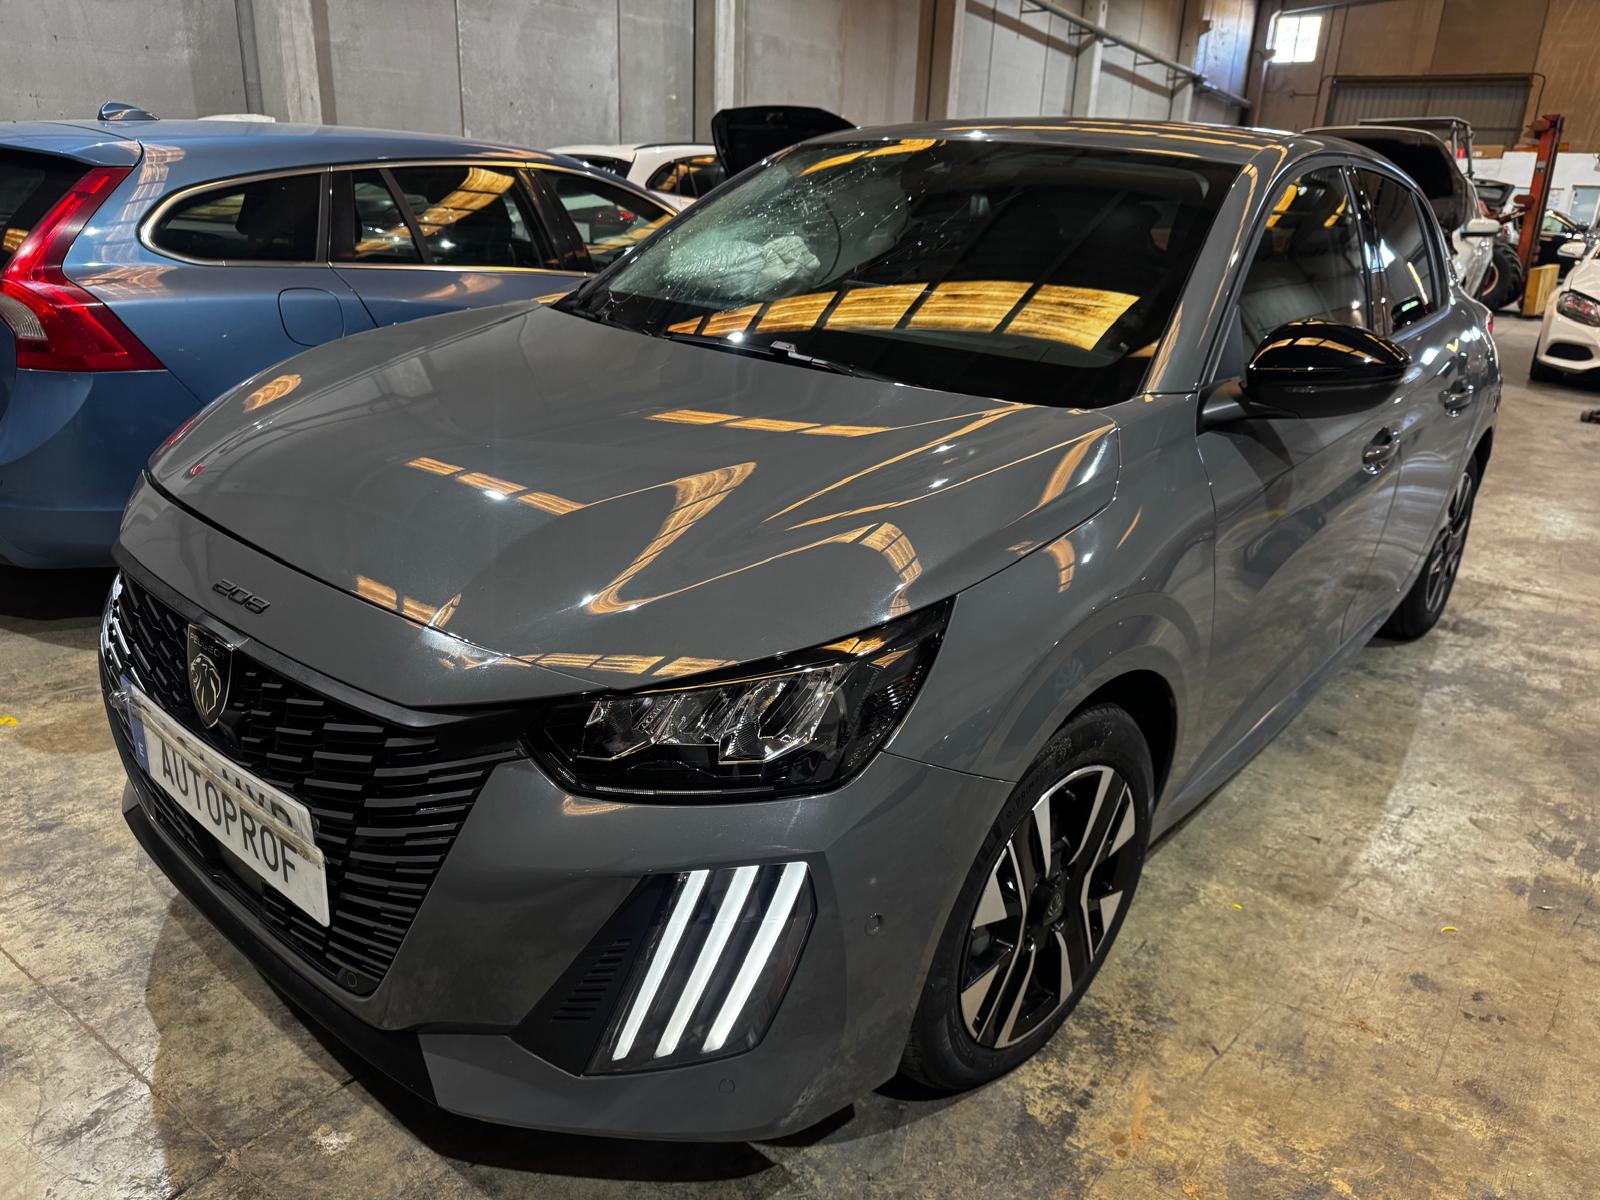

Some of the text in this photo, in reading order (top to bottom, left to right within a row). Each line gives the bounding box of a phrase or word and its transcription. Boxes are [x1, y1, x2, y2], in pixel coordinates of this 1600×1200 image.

[212, 578, 271, 614] 208
[190, 632, 225, 660] PEUGEOT
[138, 742, 145, 757] E
[161, 740, 297, 883] AUTOPROF
